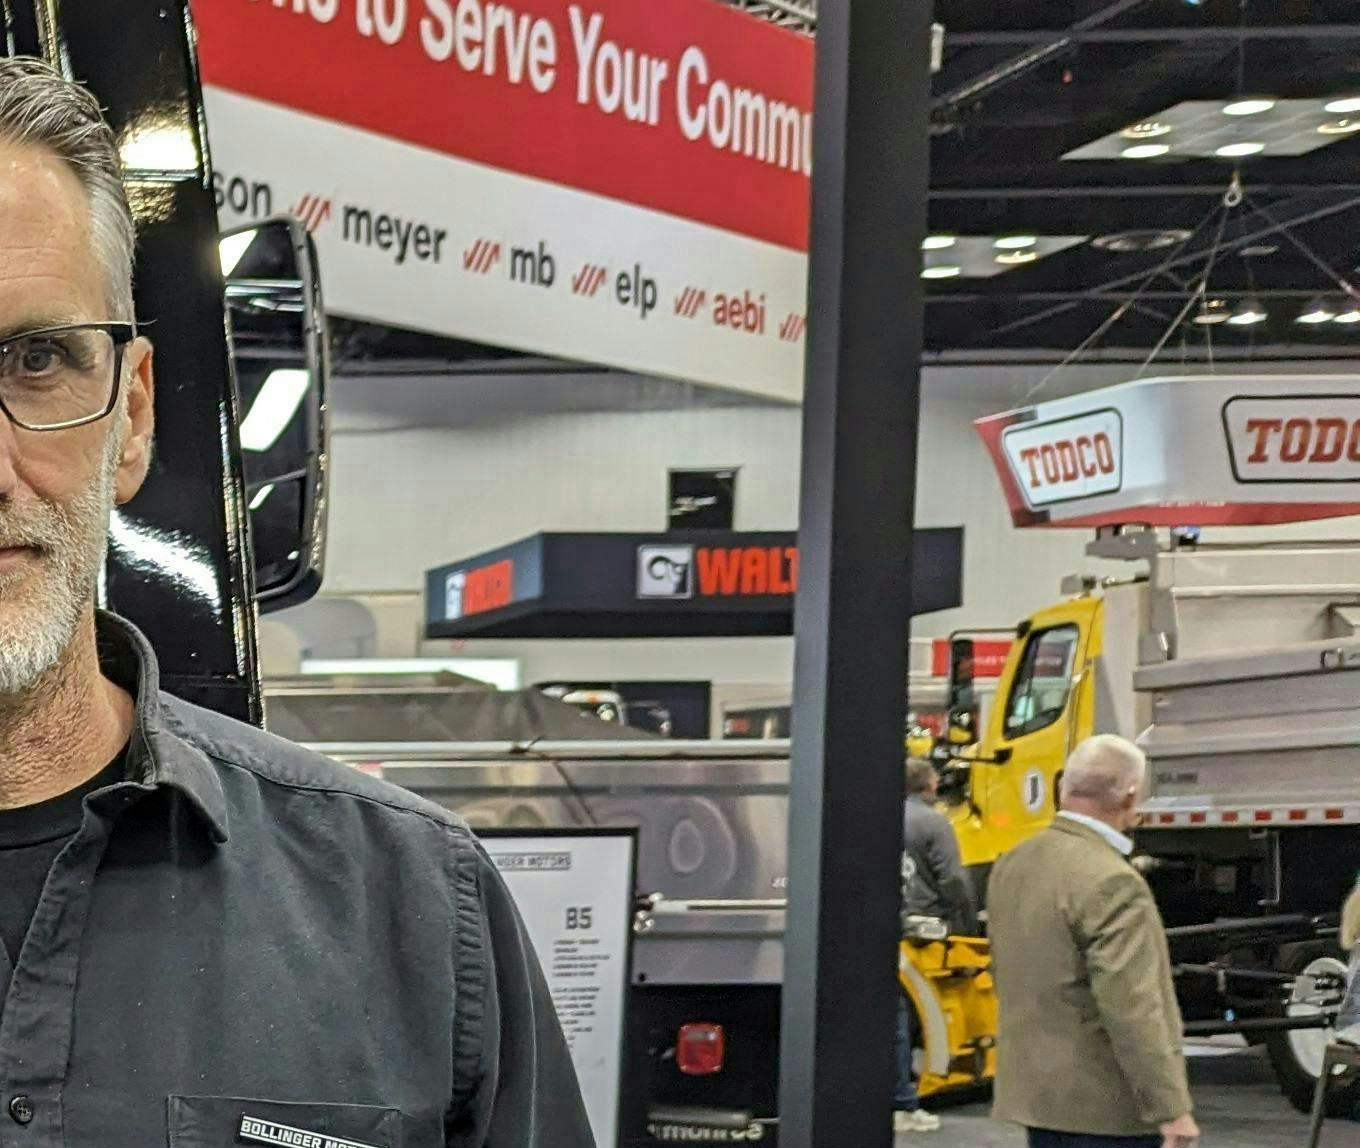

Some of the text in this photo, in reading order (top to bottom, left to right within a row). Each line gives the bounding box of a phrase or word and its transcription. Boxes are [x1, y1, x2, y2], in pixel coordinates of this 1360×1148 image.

[420, 0, 556, 92] Serve
[569, 6, 667, 126] Your
[342, 201, 447, 265] meyer
[510, 244, 555, 289] mb
[616, 269, 658, 319] elp
[712, 288, 766, 335] aebi
[1020, 430, 1116, 489] TODCO
[565, 907, 592, 929] B5
